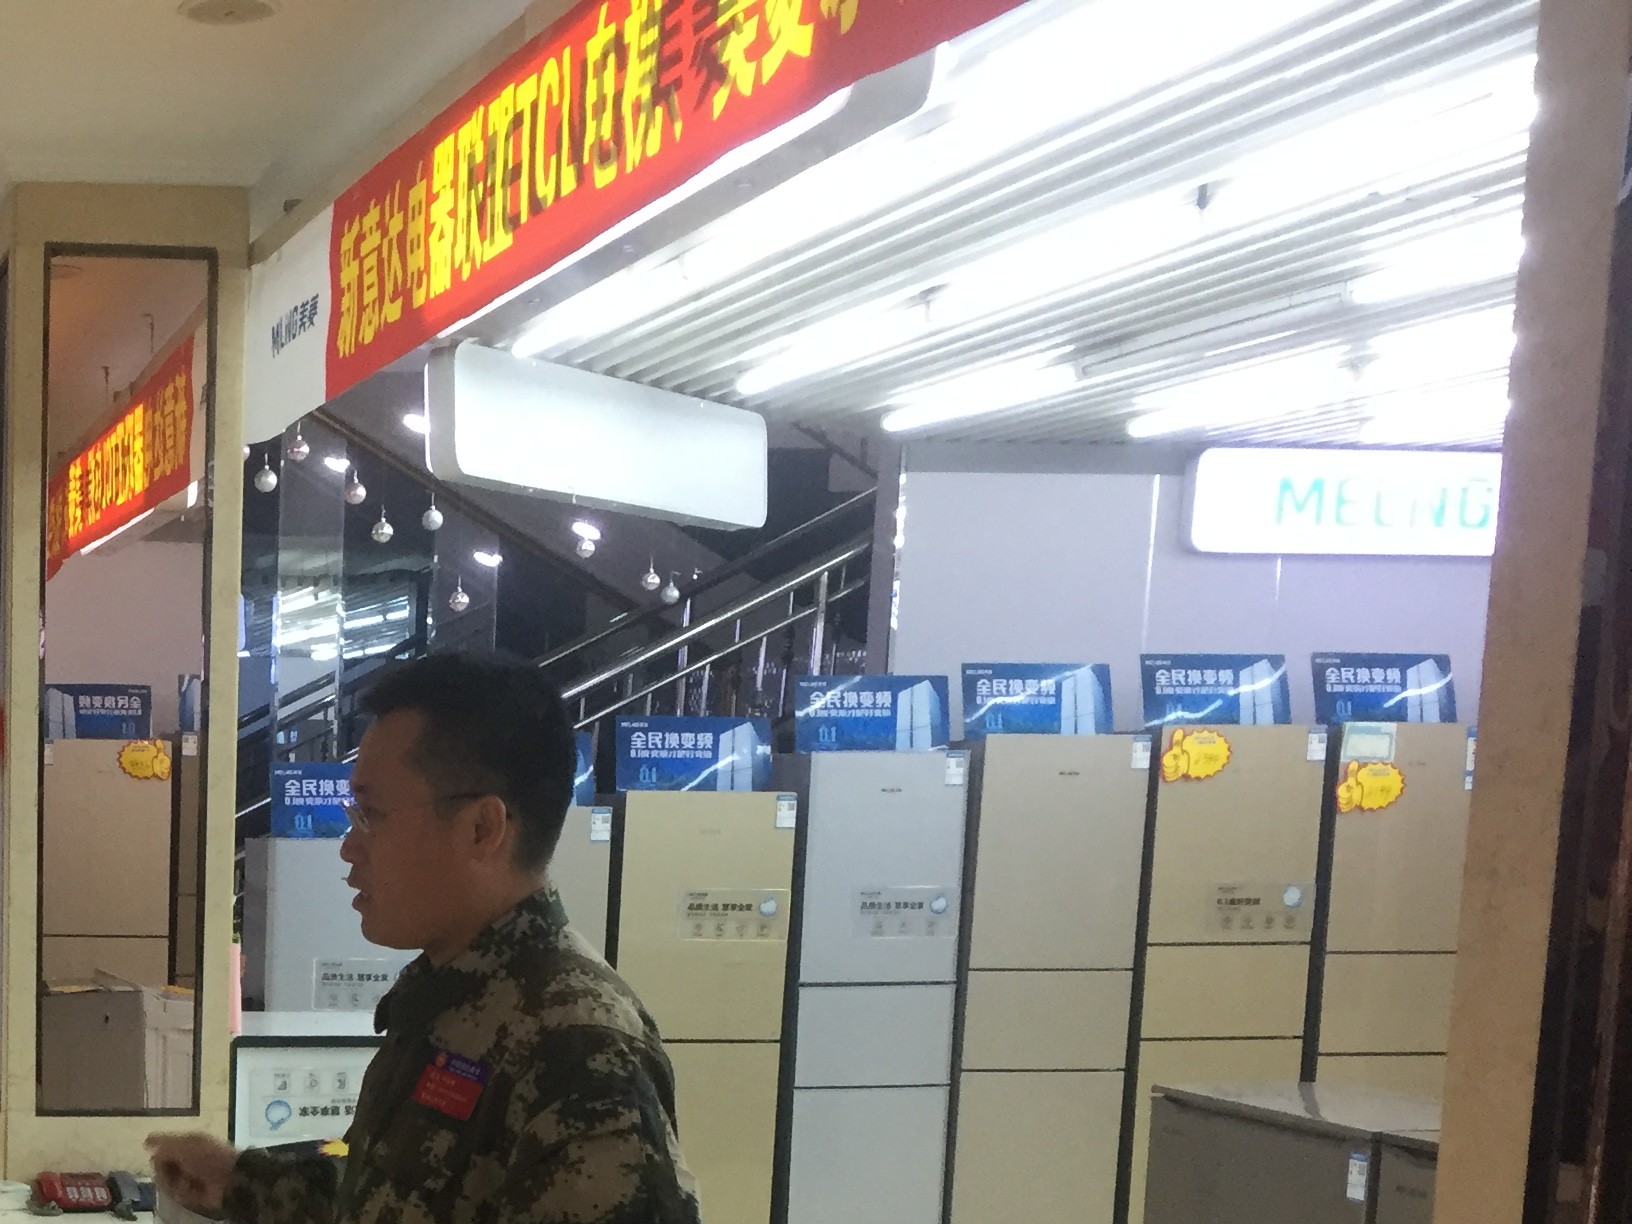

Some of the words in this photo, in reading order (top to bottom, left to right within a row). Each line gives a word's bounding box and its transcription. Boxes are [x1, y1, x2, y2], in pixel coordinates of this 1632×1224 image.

[1155, 668, 1234, 685] 全民换变频
[1325, 667, 1401, 684] 全民换变频
[809, 691, 892, 708] 全民换变频
[630, 731, 713, 749] 全民换变频
